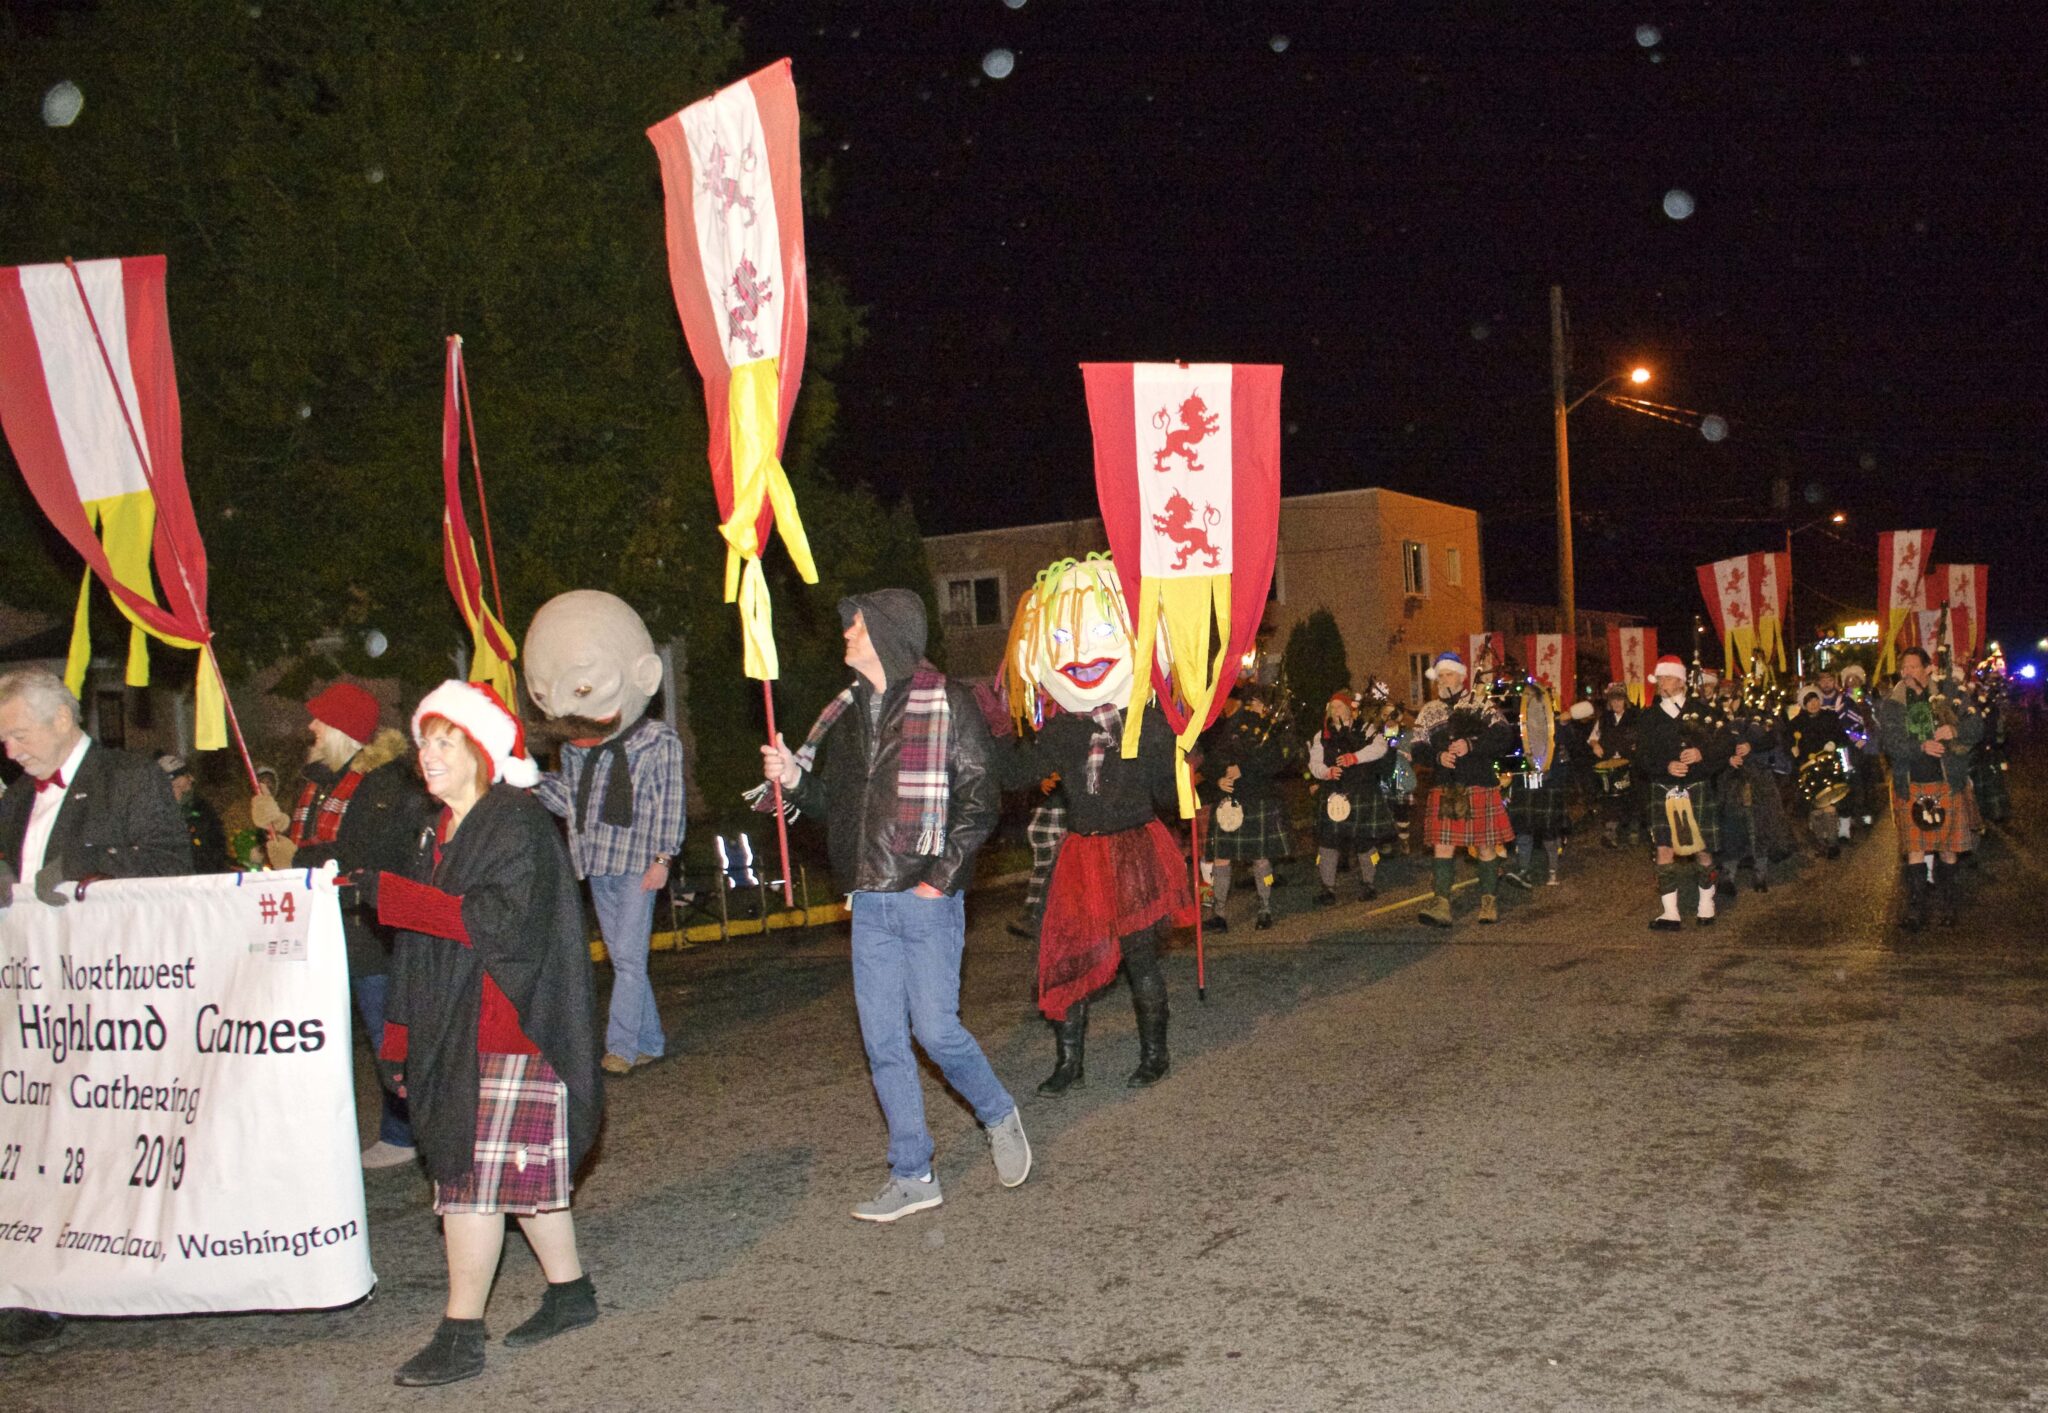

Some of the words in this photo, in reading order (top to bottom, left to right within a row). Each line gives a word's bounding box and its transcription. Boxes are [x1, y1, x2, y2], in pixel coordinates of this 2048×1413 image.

[259, 891, 296, 924] #4
[0, 957, 42, 1000] cific
[60, 954, 196, 990] Northwest
[18, 1003, 167, 1063] Highland
[196, 1004, 326, 1055] Games
[1, 1070, 52, 1106] Clan
[70, 1074, 201, 1124] Gathering
[63, 1146, 85, 1185] 28
[55, 1222, 167, 1262] Enumclaw,
[177, 1219, 359, 1260] Washington
